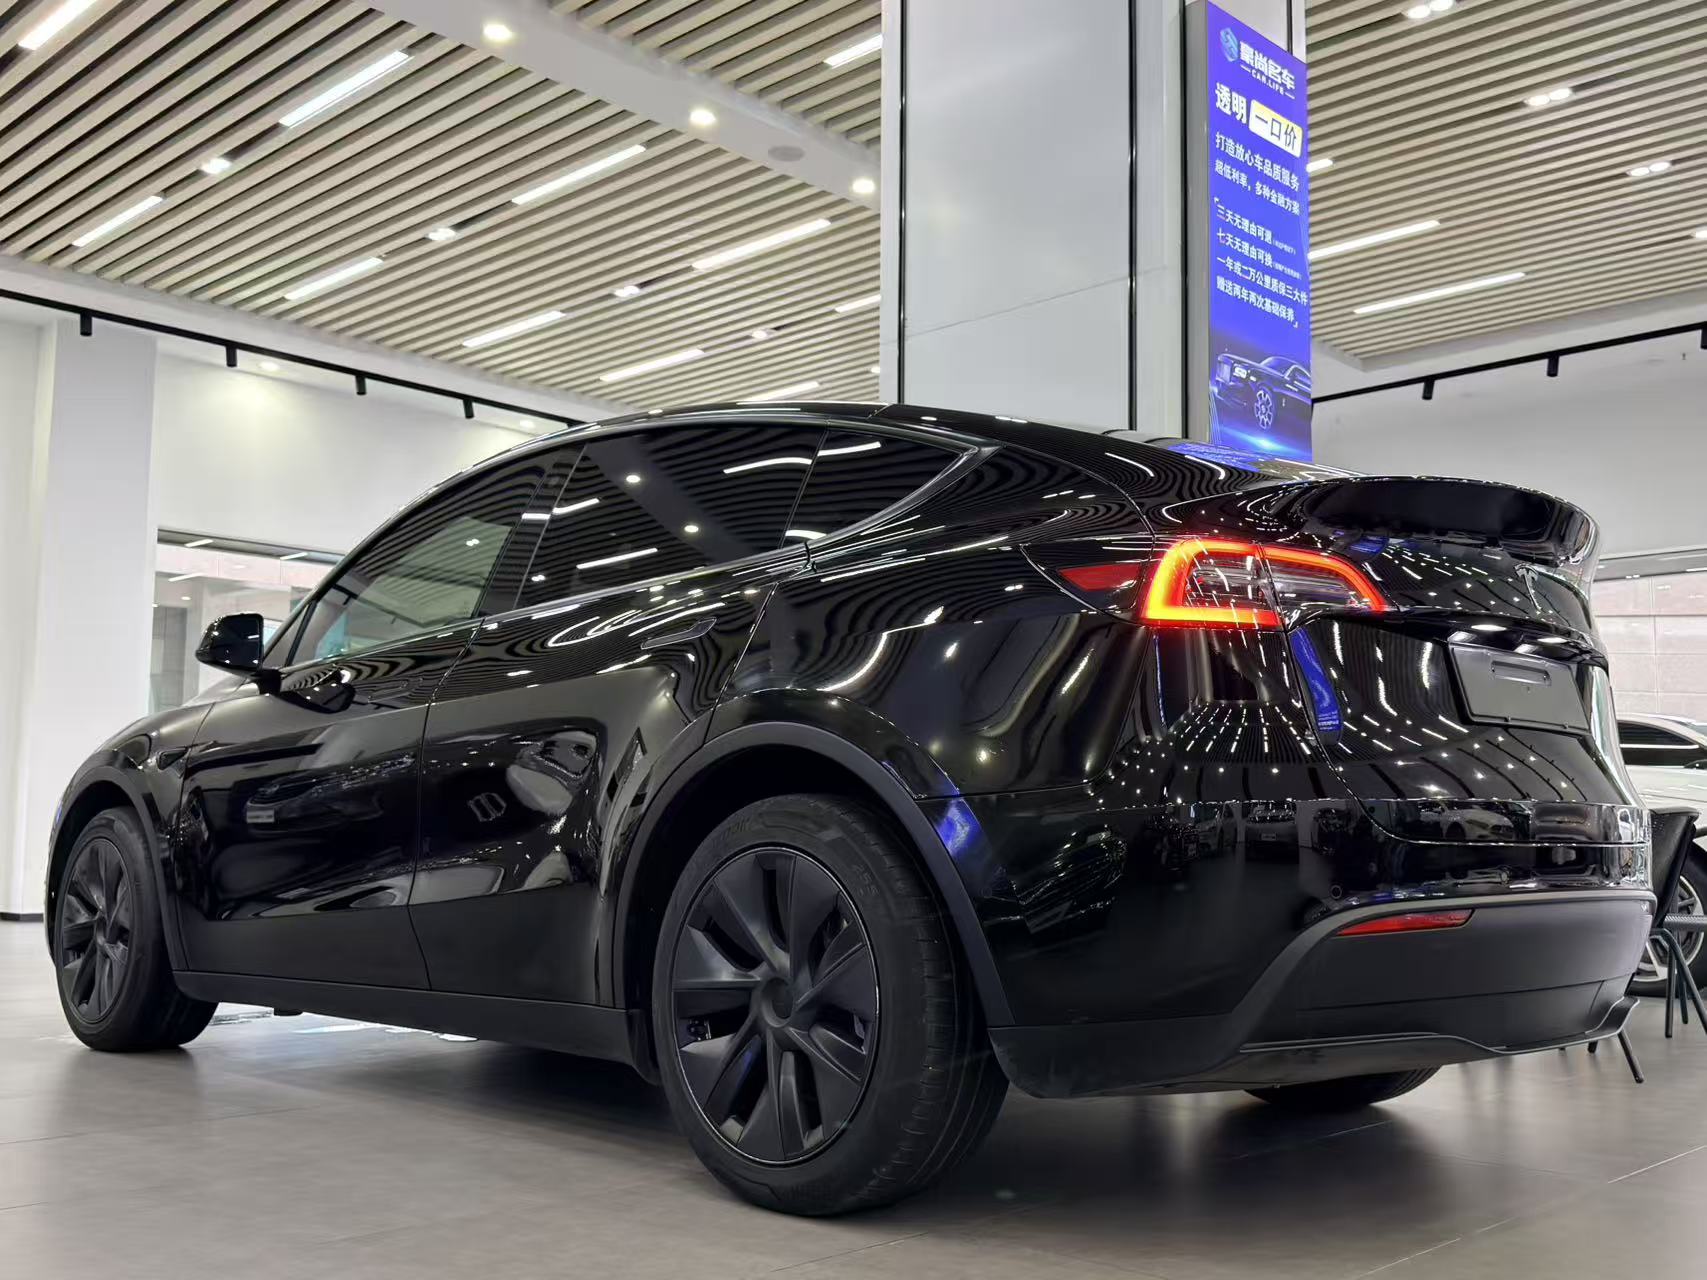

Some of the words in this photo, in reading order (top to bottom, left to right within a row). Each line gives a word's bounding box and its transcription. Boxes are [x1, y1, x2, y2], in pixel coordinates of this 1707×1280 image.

[1215, 82, 1247, 124] 透明
[1255, 114, 1297, 151] 一口价
[1215, 131, 1300, 192] 打造放心车品质服务
